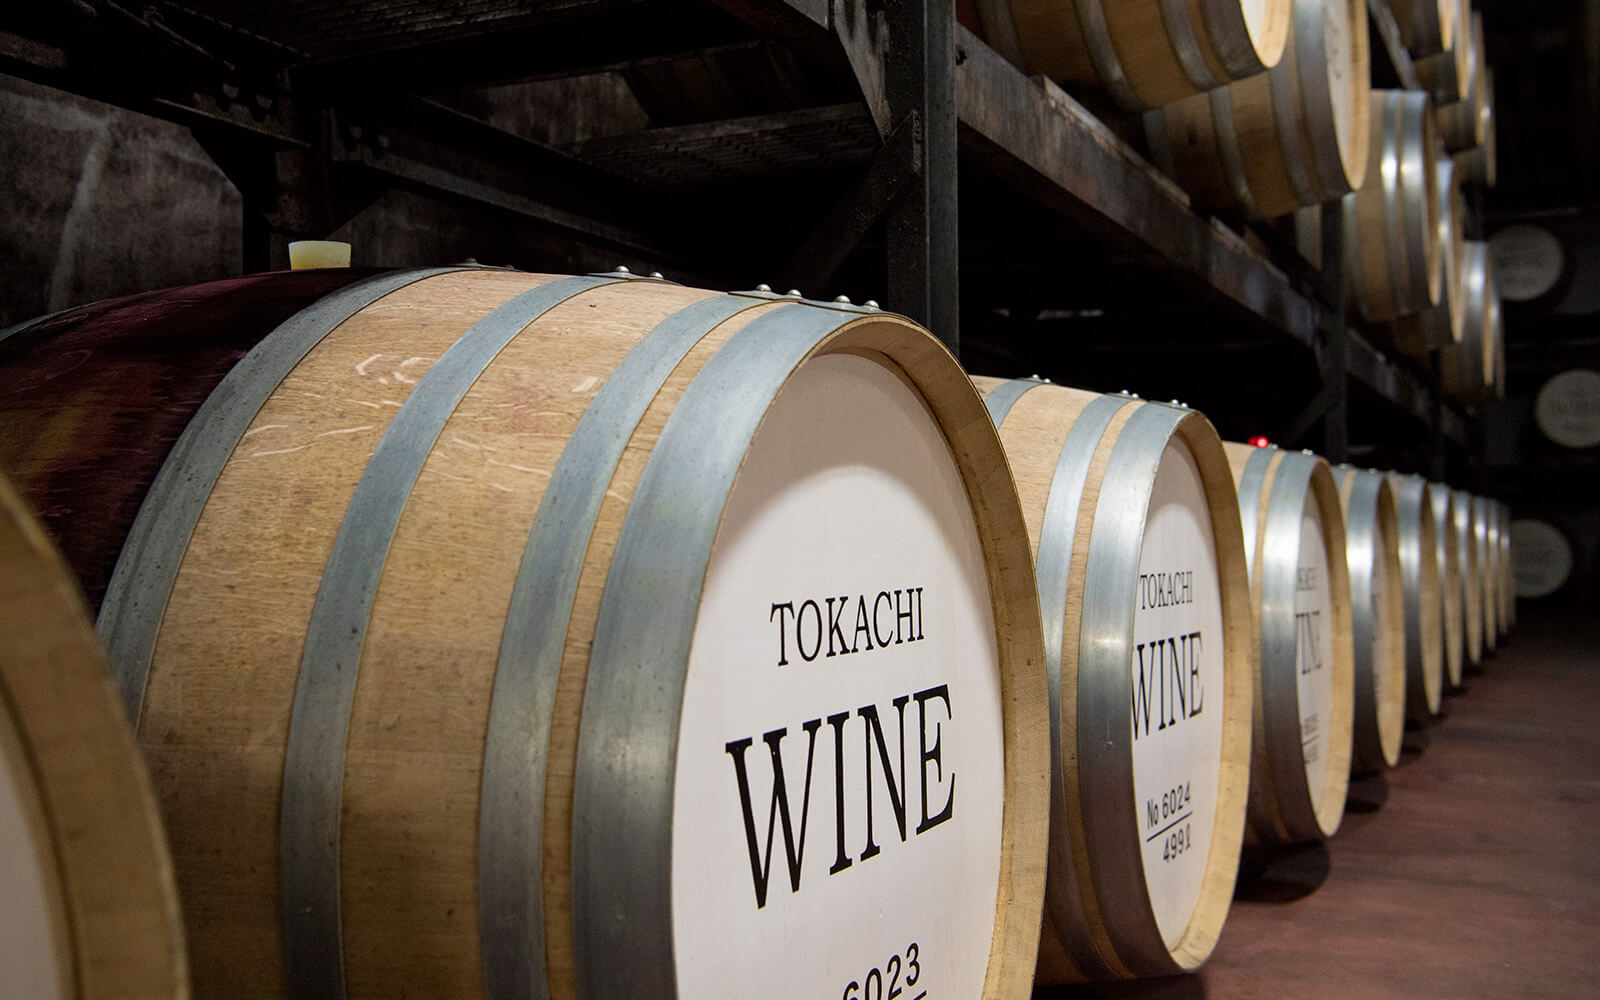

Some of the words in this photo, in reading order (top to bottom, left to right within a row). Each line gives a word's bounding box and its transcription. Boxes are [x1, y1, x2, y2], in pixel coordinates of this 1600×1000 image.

[1139, 570, 1193, 610] TOKACHI
[770, 587, 925, 666] TOKACHI
[1132, 630, 1204, 741] WINE
[725, 683, 956, 909] WINE
[1147, 797, 1159, 831] No
[1161, 780, 1191, 819] 6024
[842, 942, 921, 1000] 6023
